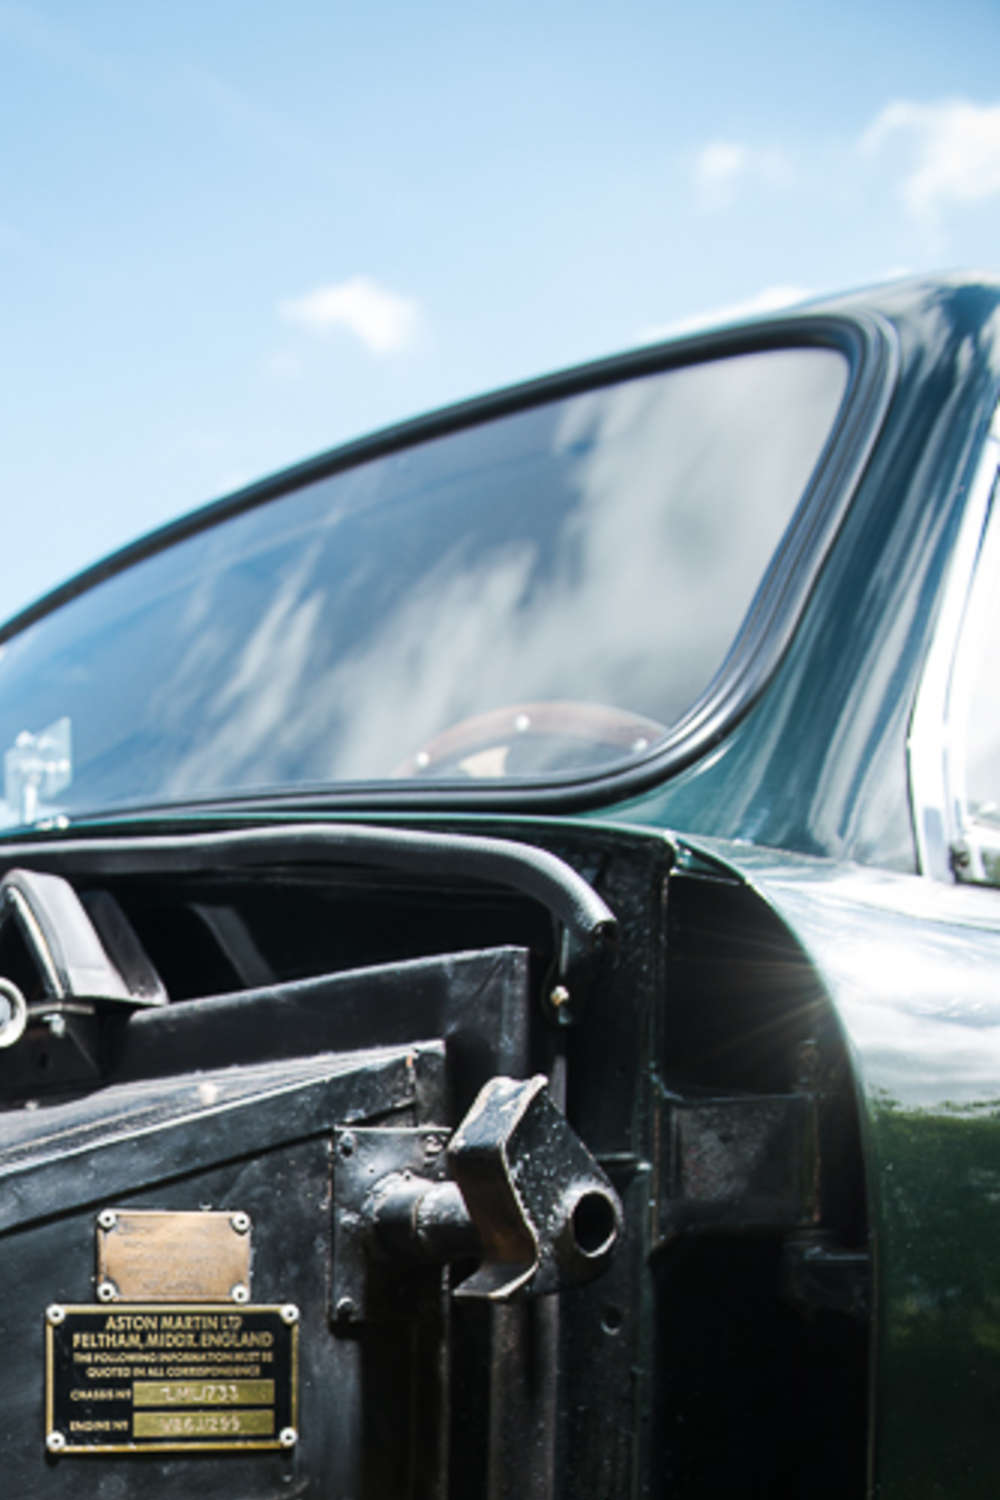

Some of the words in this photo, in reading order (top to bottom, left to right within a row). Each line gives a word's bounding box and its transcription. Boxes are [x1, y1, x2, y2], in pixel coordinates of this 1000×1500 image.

[105, 1315, 159, 1330] ASTON
[160, 1315, 218, 1330] MARTIN
[72, 1332, 144, 1349] FELTHAM,
[201, 1331, 274, 1347] ENGLAND
[73, 1352, 92, 1363] THE
[94, 1352, 156, 1363] FOLLOWING
[159, 1352, 232, 1363] INFORMATION
[86, 1366, 130, 1378] QUOTED
[133, 1366, 144, 1377] IN
[146, 1366, 164, 1377] ALL
[166, 1366, 261, 1377] CORRESPONDENCE
[70, 1388, 114, 1401] CHASSIS
[70, 1420, 110, 1432] ENGINE
